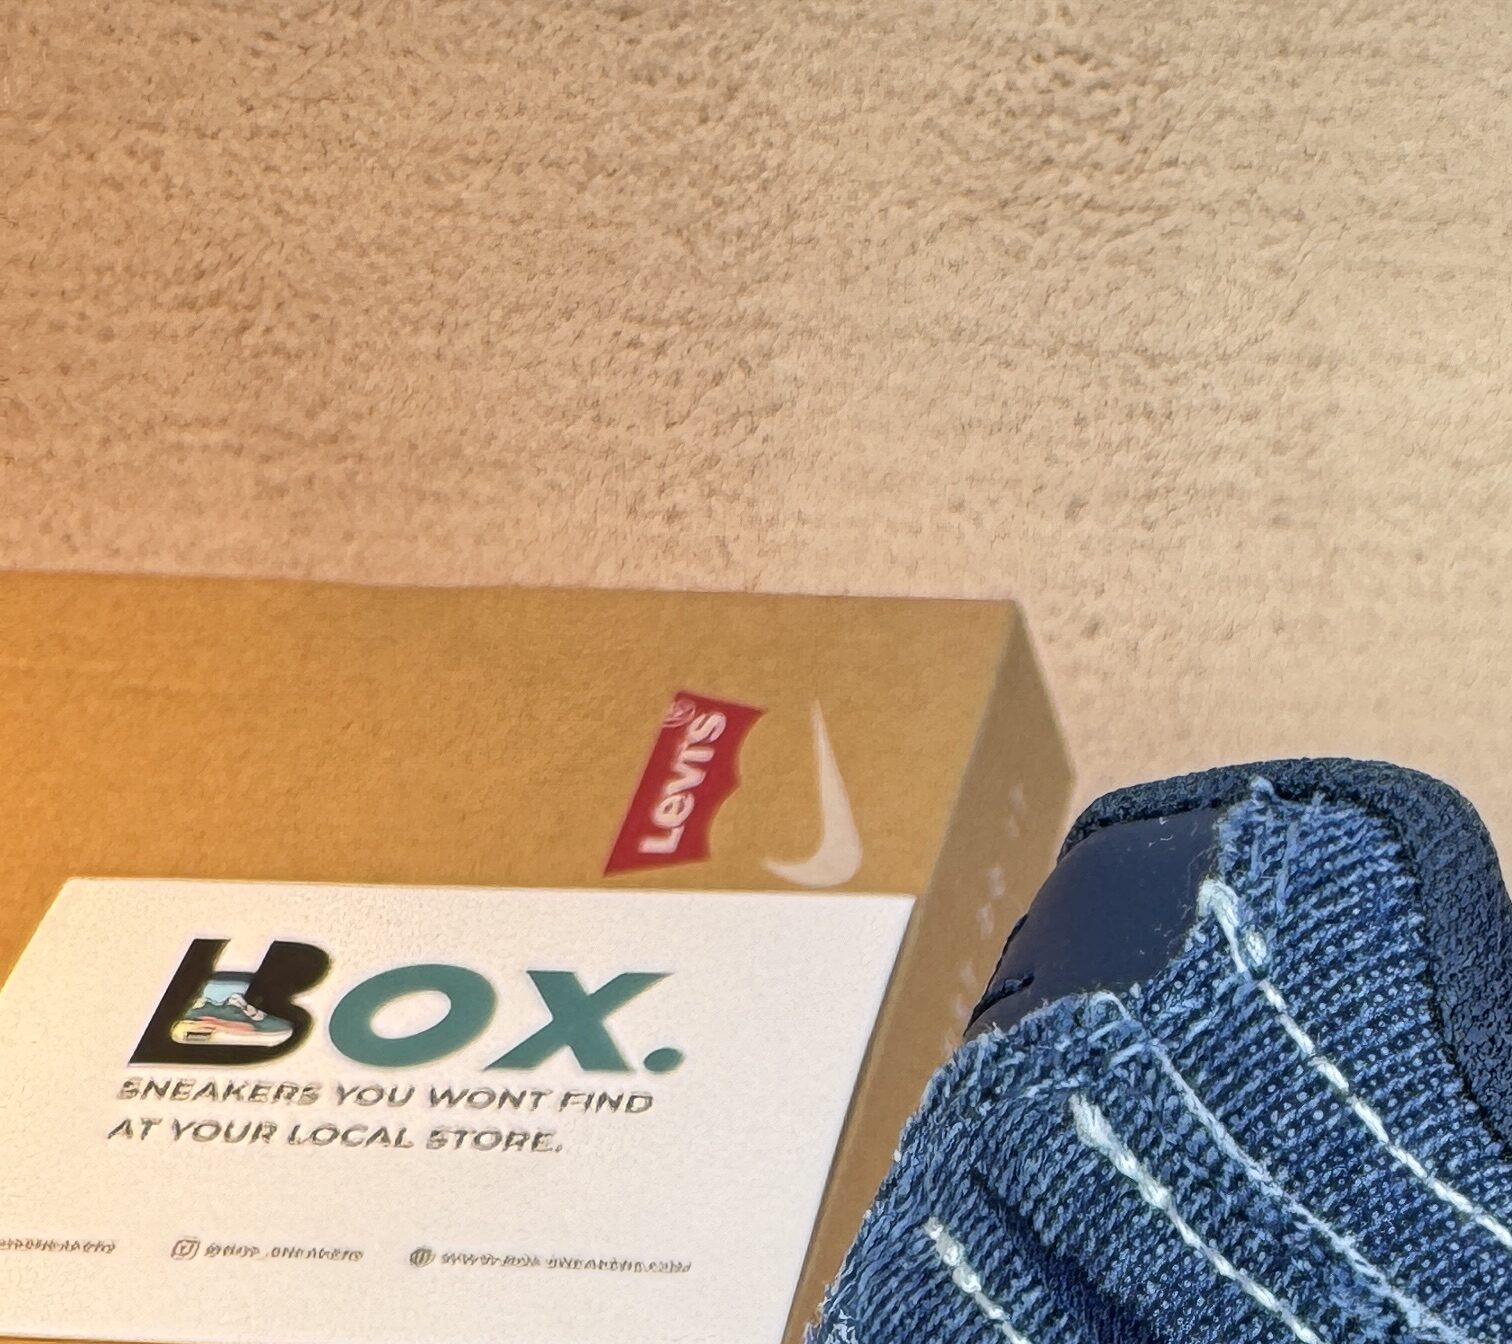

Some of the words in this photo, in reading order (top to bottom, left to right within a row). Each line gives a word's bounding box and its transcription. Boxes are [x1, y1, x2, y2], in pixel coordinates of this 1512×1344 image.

[116, 1076, 323, 1105] SNEAKERS
[336, 1081, 415, 1108] YOU
[430, 1085, 553, 1111] WONT
[559, 1090, 653, 1113] FIND
[107, 1117, 162, 1141] AT
[171, 1118, 278, 1144] YOUR
[288, 1122, 414, 1149] LOCAL
[425, 1126, 563, 1153] STORE.
